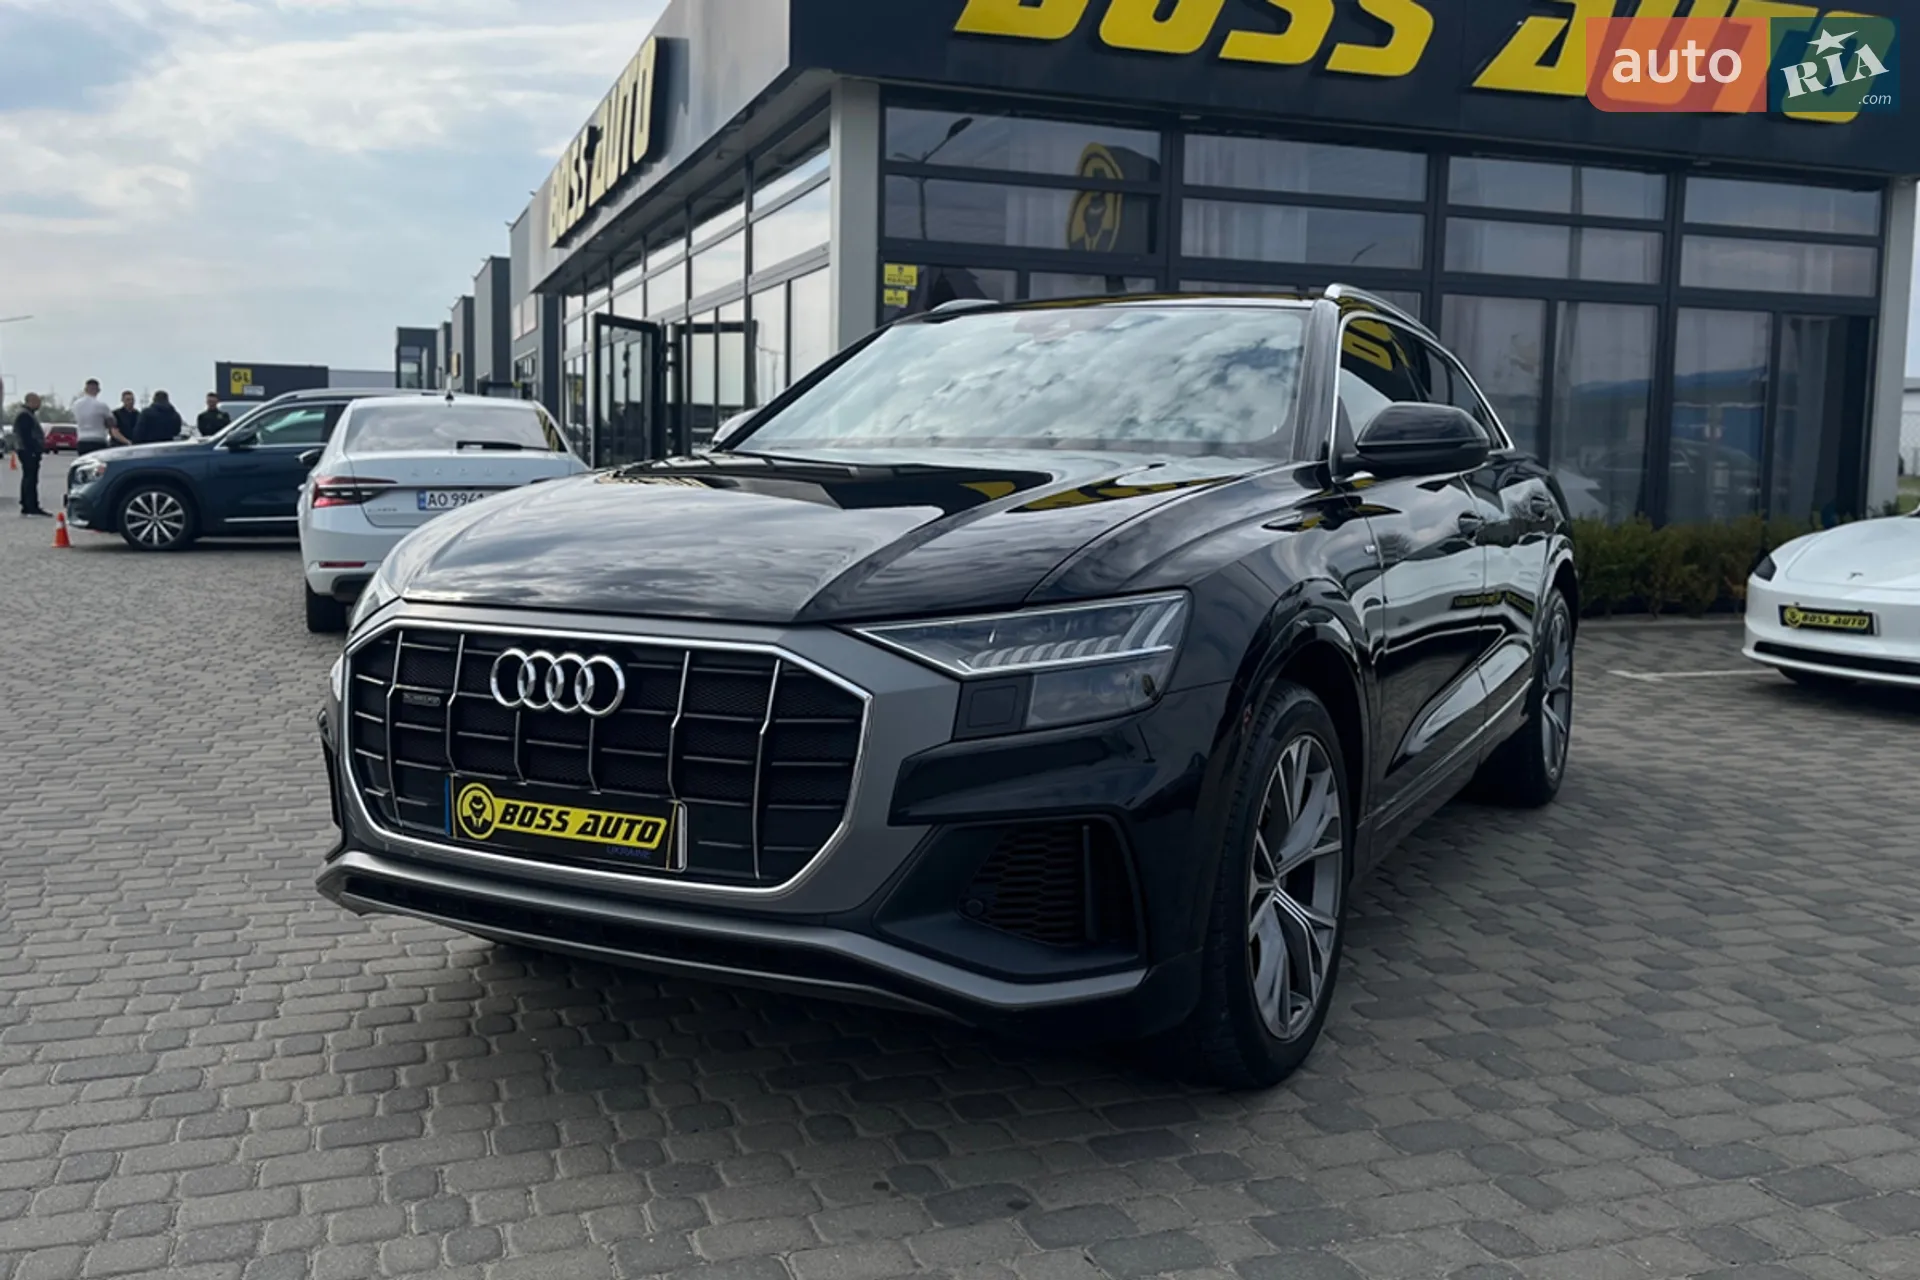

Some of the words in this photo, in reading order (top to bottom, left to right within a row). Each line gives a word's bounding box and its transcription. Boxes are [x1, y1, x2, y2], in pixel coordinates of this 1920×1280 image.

[550, 125, 589, 248] BOSS
[588, 34, 657, 208] AUTO
[427, 492, 448, 507] AO
[1802, 614, 1830, 624] BOSS
[1832, 617, 1867, 627] AUTO
[498, 803, 571, 833] BOSS
[575, 813, 662, 844] AUTO
